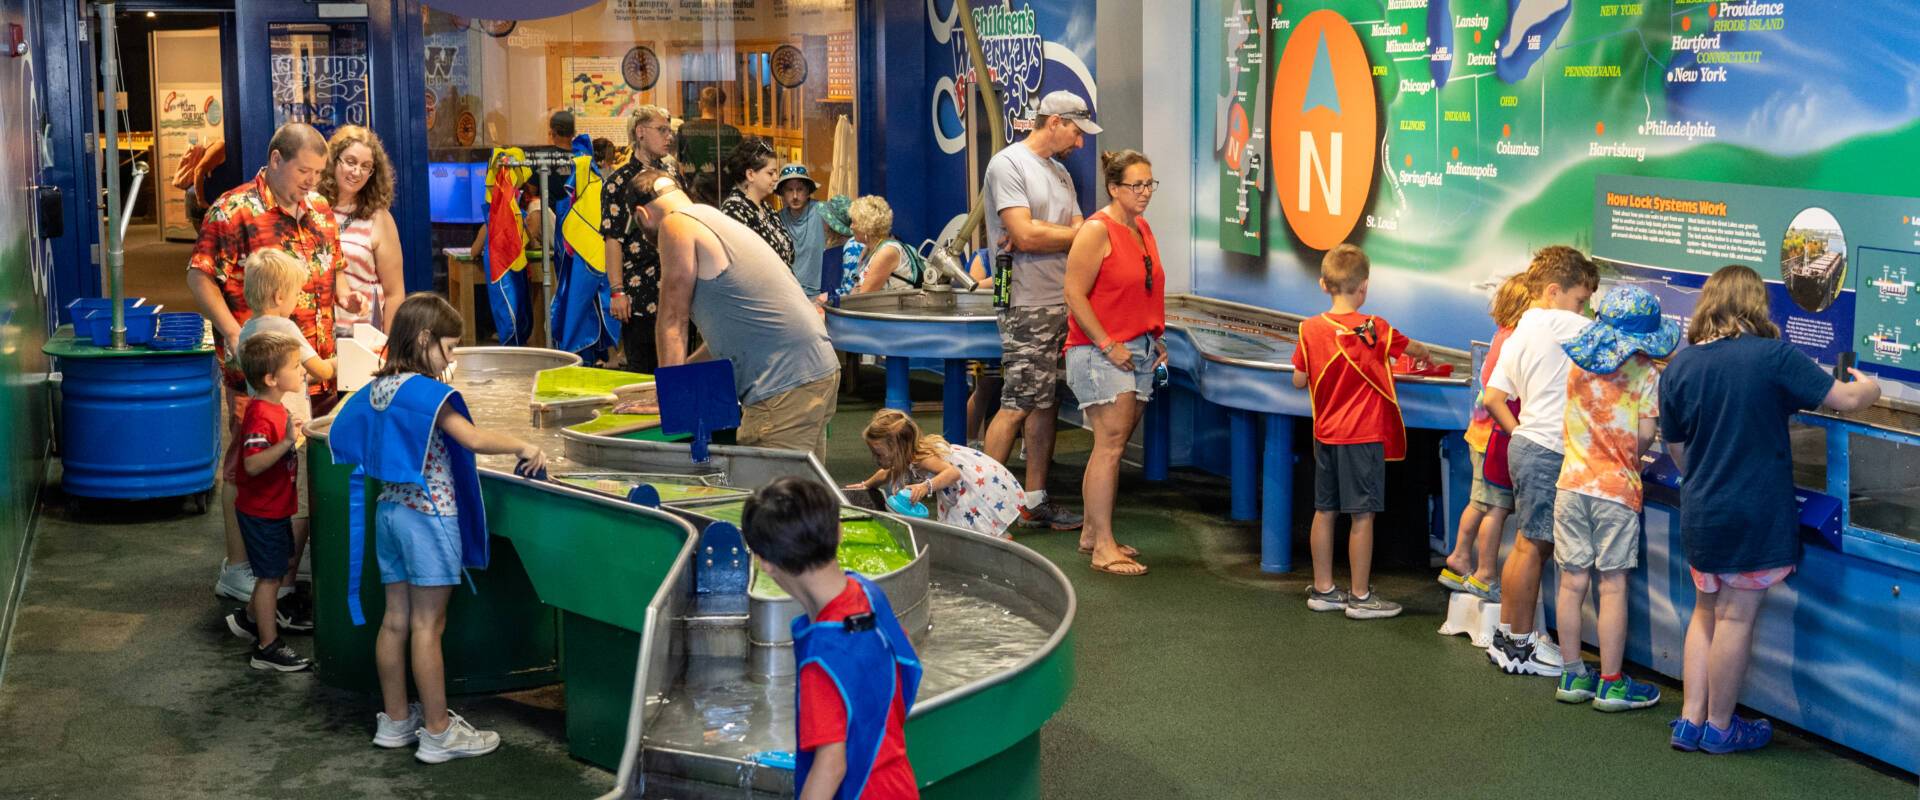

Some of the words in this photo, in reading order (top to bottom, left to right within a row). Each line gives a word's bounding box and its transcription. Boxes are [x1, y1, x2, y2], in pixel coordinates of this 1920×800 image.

[1600, 5, 1619, 17] NEW
[1620, 3, 1643, 16] YORK
[1718, 2, 1784, 18] Providence
[972, 3, 1035, 37] Children's
[1271, 18, 1290, 30] Pierre
[1455, 15, 1489, 31] Lansing
[1713, 19, 1746, 32] RHODE
[1748, 18, 1784, 31] ISLAND
[1371, 25, 1402, 37] Madison
[1385, 39, 1425, 53] Milwaukee
[1671, 34, 1721, 53] Hartford
[1467, 52, 1497, 66] Detroit
[1696, 51, 1762, 64] CONNECTICUT
[1372, 66, 1388, 77] IOWA
[1564, 65, 1621, 78] PENNSYLVANIA
[1674, 68, 1698, 83] New
[1700, 66, 1727, 83] York
[1399, 79, 1430, 94] Chicago
[1499, 96, 1518, 107] OHIO
[1444, 111, 1471, 122] INDIANA
[1399, 120, 1426, 131] ILLINOIS
[1645, 119, 1716, 140] Philadelphia
[1228, 135, 1239, 161] N
[1496, 142, 1539, 156] Columbus
[1588, 142, 1646, 162] Harrisburg
[1299, 131, 1342, 216] N
[1446, 162, 1497, 179] Indianapolis
[1399, 171, 1442, 188] Springfield
[1607, 192, 1629, 206] How
[1630, 194, 1652, 210] Lock
[1653, 197, 1698, 214] Systems
[1699, 200, 1727, 217] Work
[1366, 215, 1378, 228] St.
[1380, 216, 1398, 230] Louis
